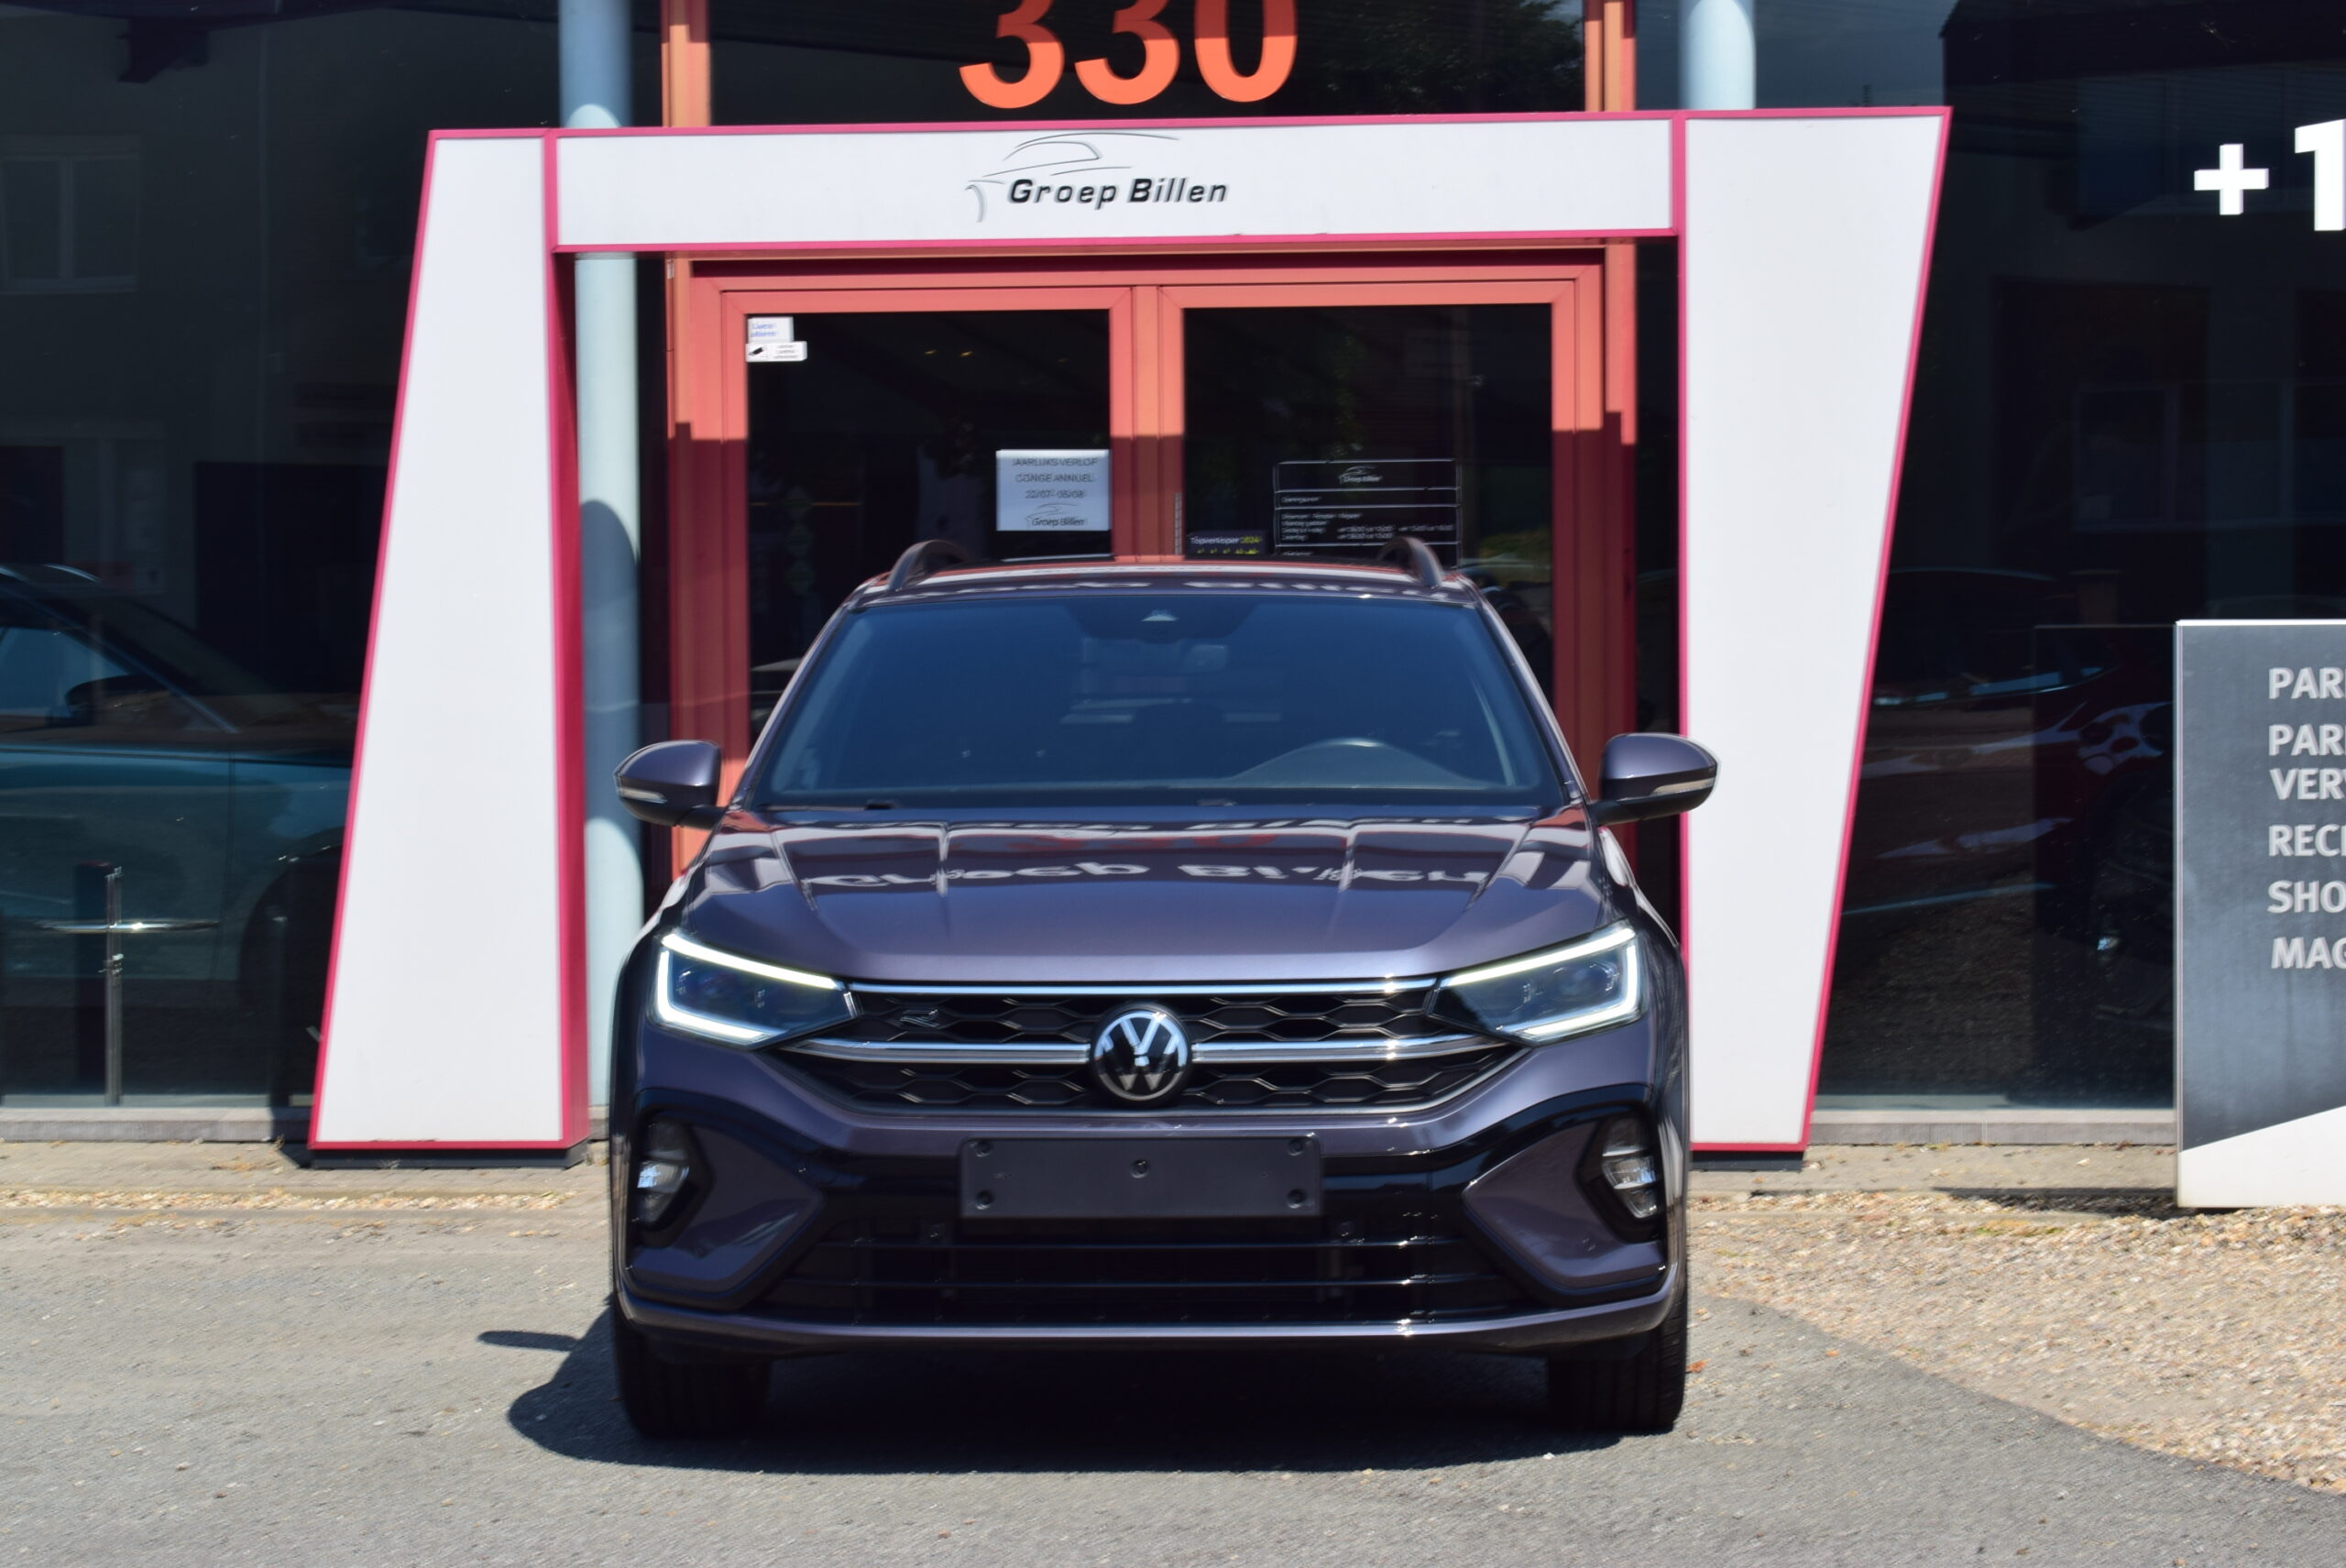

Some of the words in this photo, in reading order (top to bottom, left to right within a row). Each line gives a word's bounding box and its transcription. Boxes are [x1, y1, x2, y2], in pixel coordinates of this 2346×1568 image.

[959, 0, 1298, 108] 330
[1008, 178, 1116, 210] Groep
[1126, 177, 1228, 203] Billen
[2268, 666, 2346, 699] PAR
[2268, 723, 2346, 756] PAR
[2269, 767, 2346, 800] VER
[2268, 823, 2346, 857] REC
[2266, 879, 2346, 914] SHO
